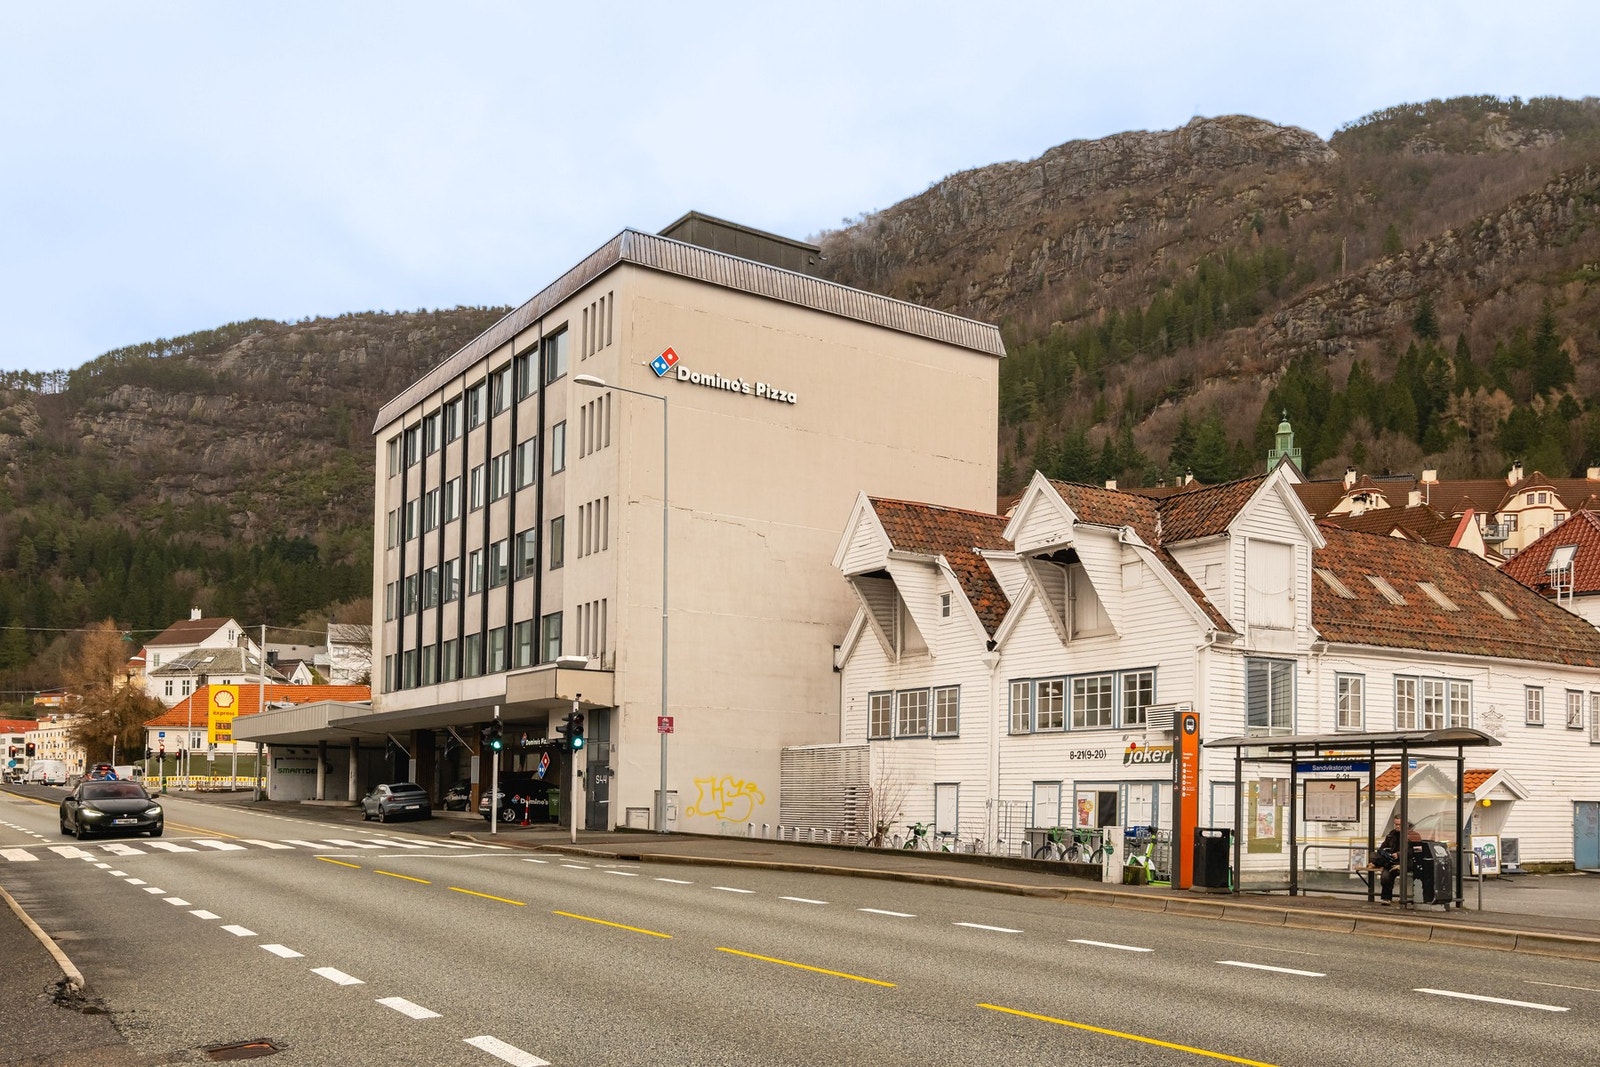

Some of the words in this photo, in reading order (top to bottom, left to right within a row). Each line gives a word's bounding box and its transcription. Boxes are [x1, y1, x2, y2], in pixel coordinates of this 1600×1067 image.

[677, 365, 751, 394] Domino's
[755, 382, 798, 404] Pizza
[1069, 749, 1107, 760] 8-21(9-20)
[1123, 741, 1171, 767] joker
[277, 767, 318, 775] SMARTDE
[520, 797, 549, 806] Dmino's
